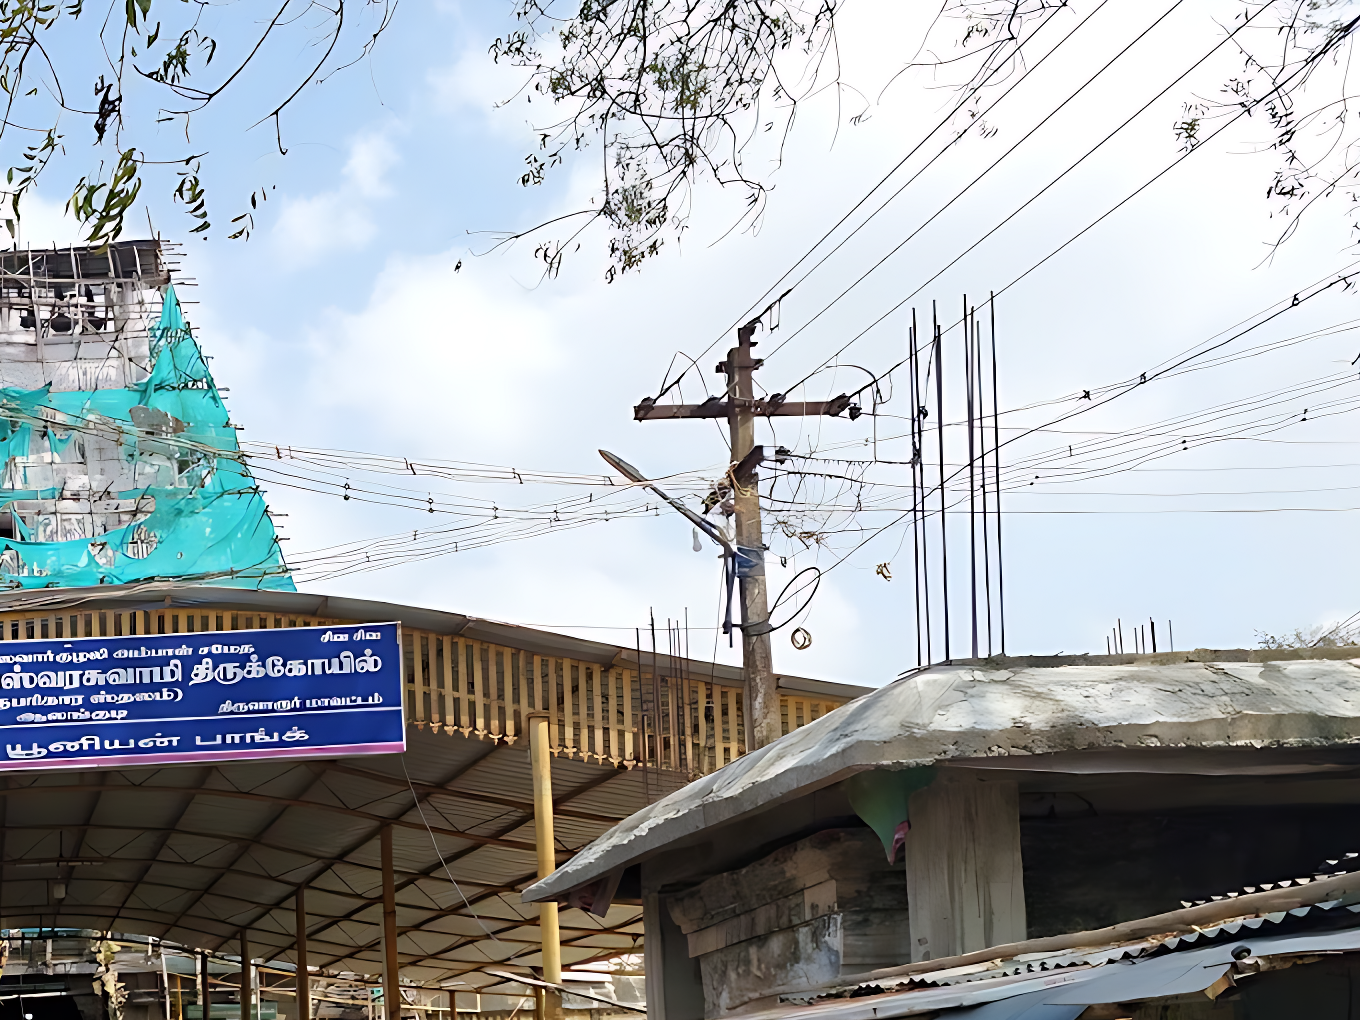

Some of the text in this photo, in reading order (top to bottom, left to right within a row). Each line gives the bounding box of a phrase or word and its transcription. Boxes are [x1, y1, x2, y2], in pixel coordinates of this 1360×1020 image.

[189, 649, 382, 687] திருக்கோயில்
[306, 693, 383, 708] மாவட்டம்
[6, 732, 181, 759] யூனியன்
[195, 726, 310, 746] பாங்க்
